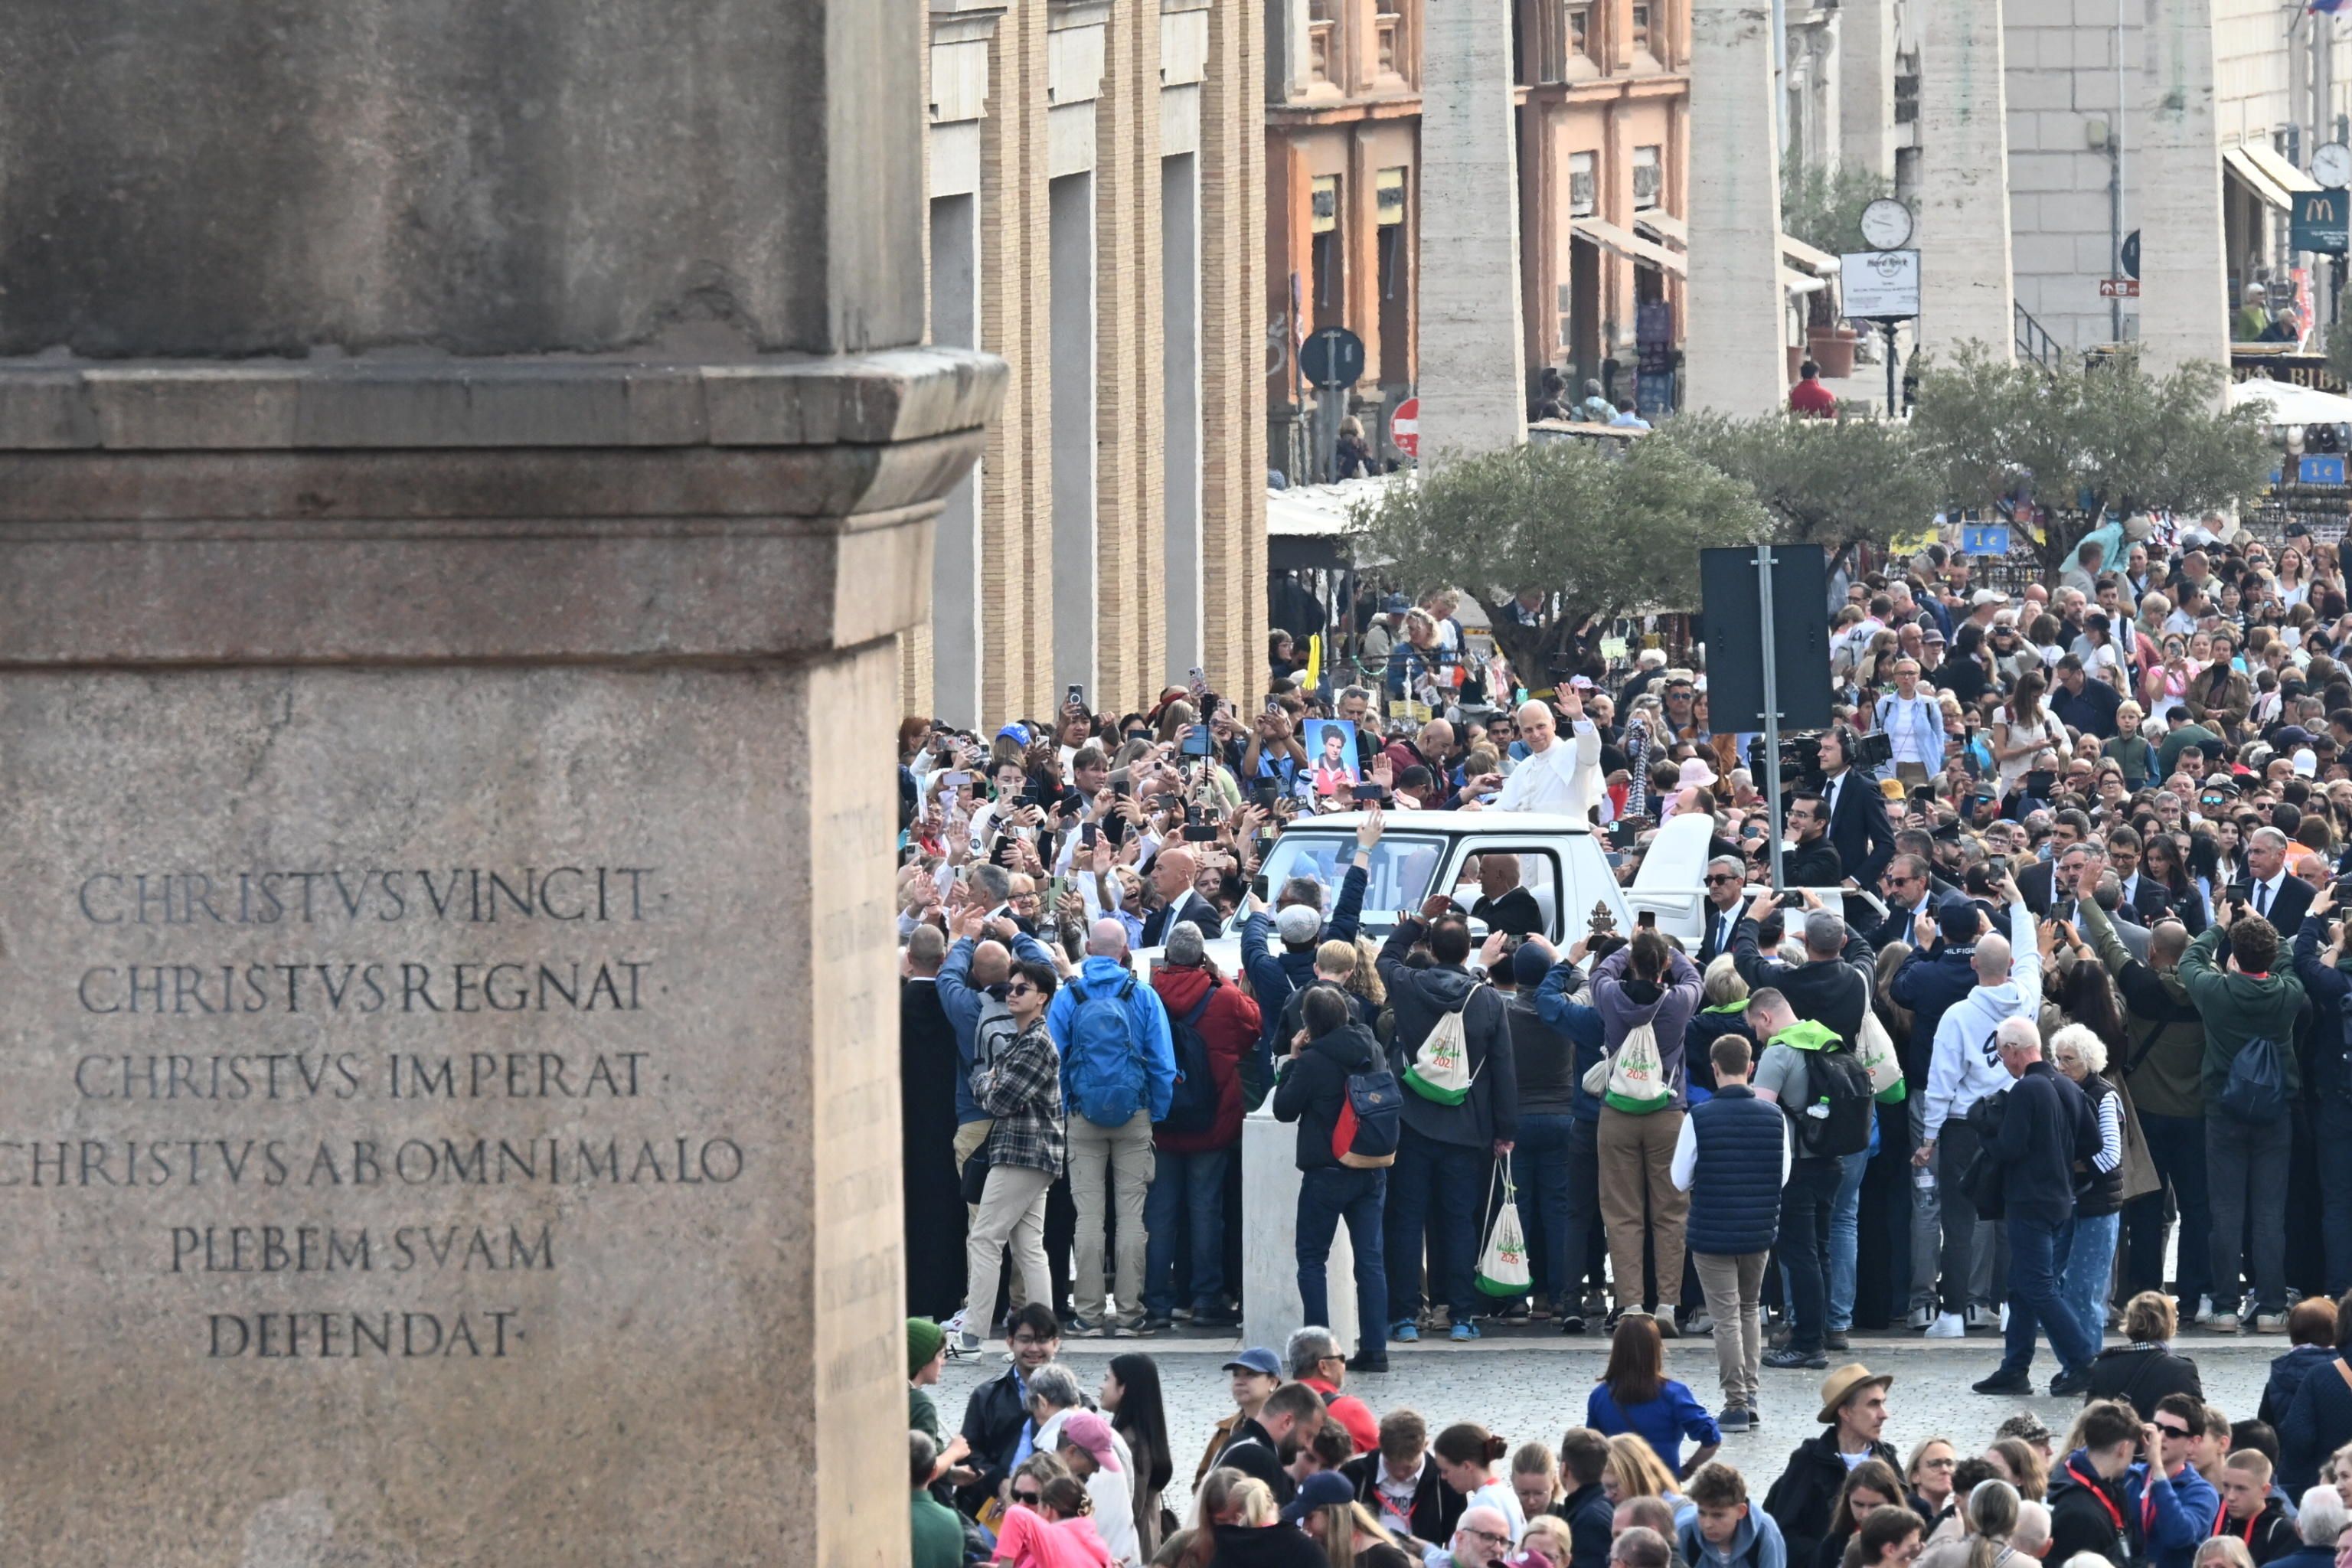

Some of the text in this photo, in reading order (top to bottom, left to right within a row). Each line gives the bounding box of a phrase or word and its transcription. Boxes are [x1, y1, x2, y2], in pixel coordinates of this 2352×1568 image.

[78, 870, 404, 924] CHRISTVS
[77, 963, 386, 1014] CHRISTVS
[74, 1052, 360, 1100] CHRISTVS
[1625, 1067, 1648, 1081] 2025
[304, 1138, 381, 1185] AB
[395, 1138, 560, 1185] OMNI
[576, 1138, 744, 1185] MALO
[169, 1223, 555, 1273] PLEBEM SVAM
[1501, 1251, 1519, 1265] 2025
